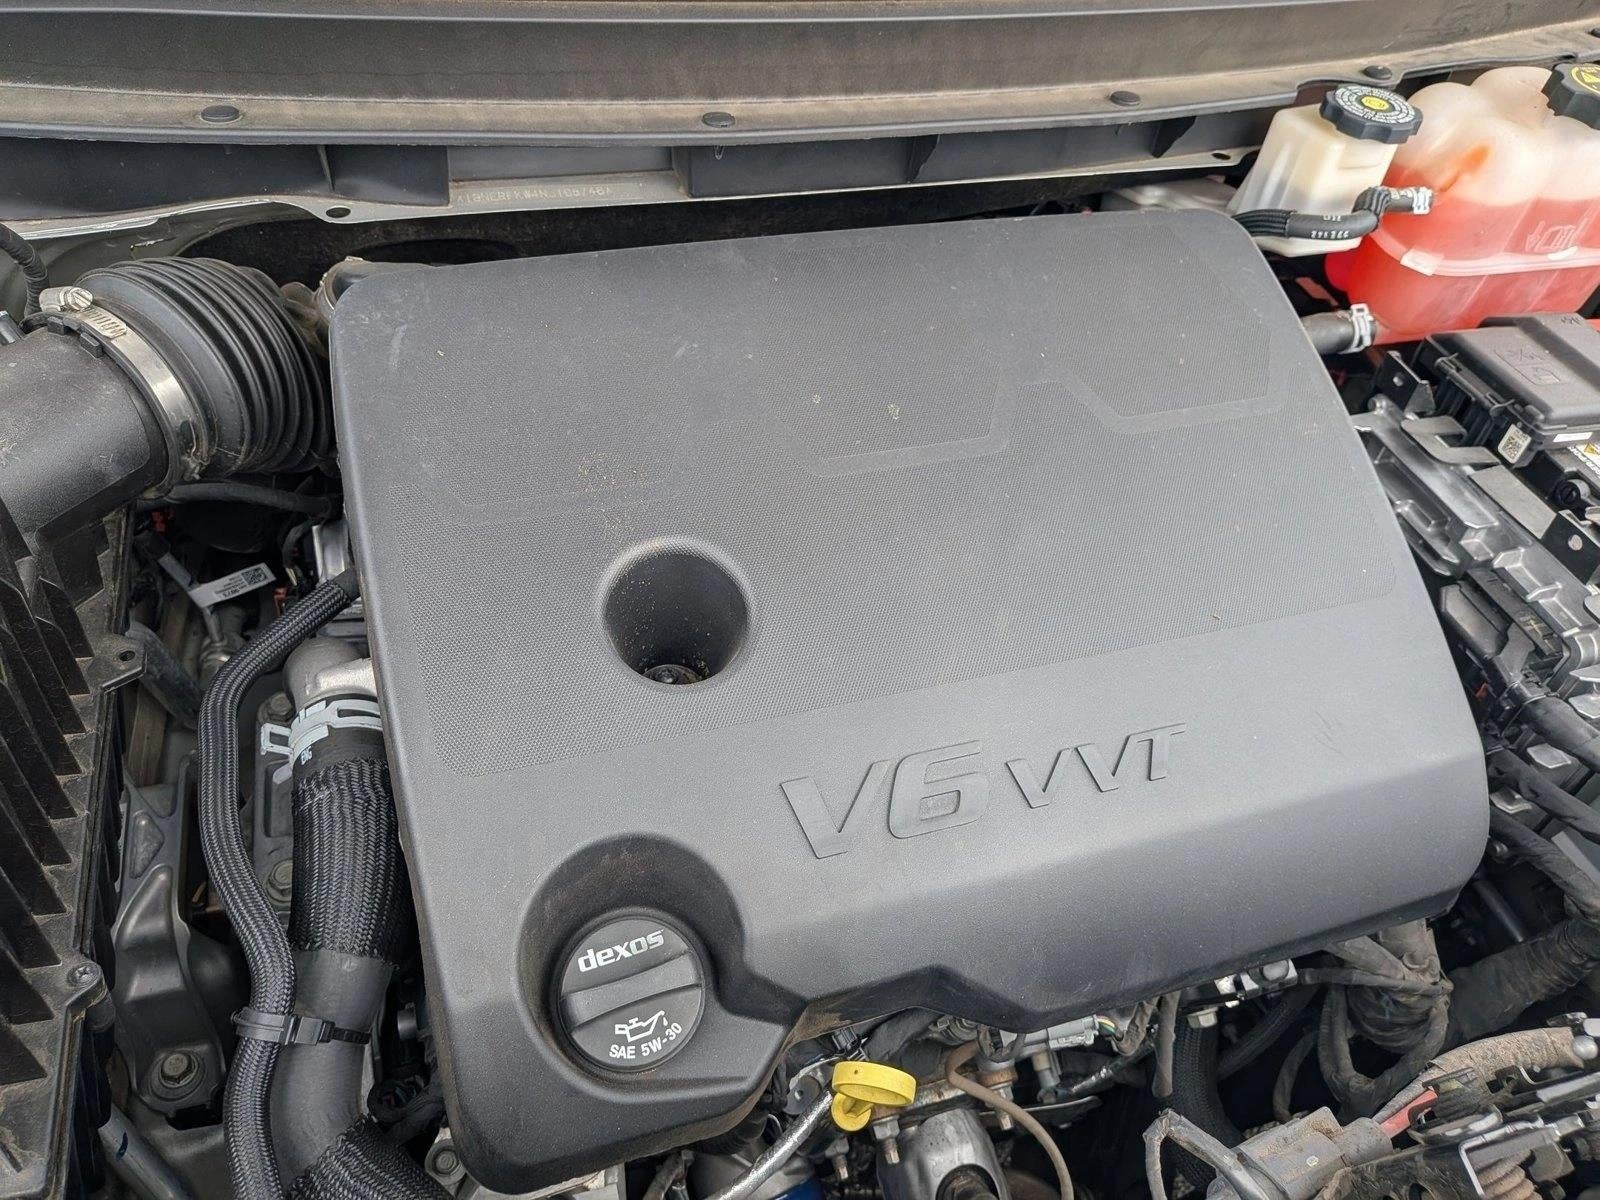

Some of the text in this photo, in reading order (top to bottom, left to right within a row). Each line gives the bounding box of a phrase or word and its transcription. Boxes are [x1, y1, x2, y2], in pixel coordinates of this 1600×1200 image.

[779, 722, 1187, 860] V6 VVT
[578, 929, 665, 973] dexos
[609, 1022, 683, 1059] SAE 5W-30
